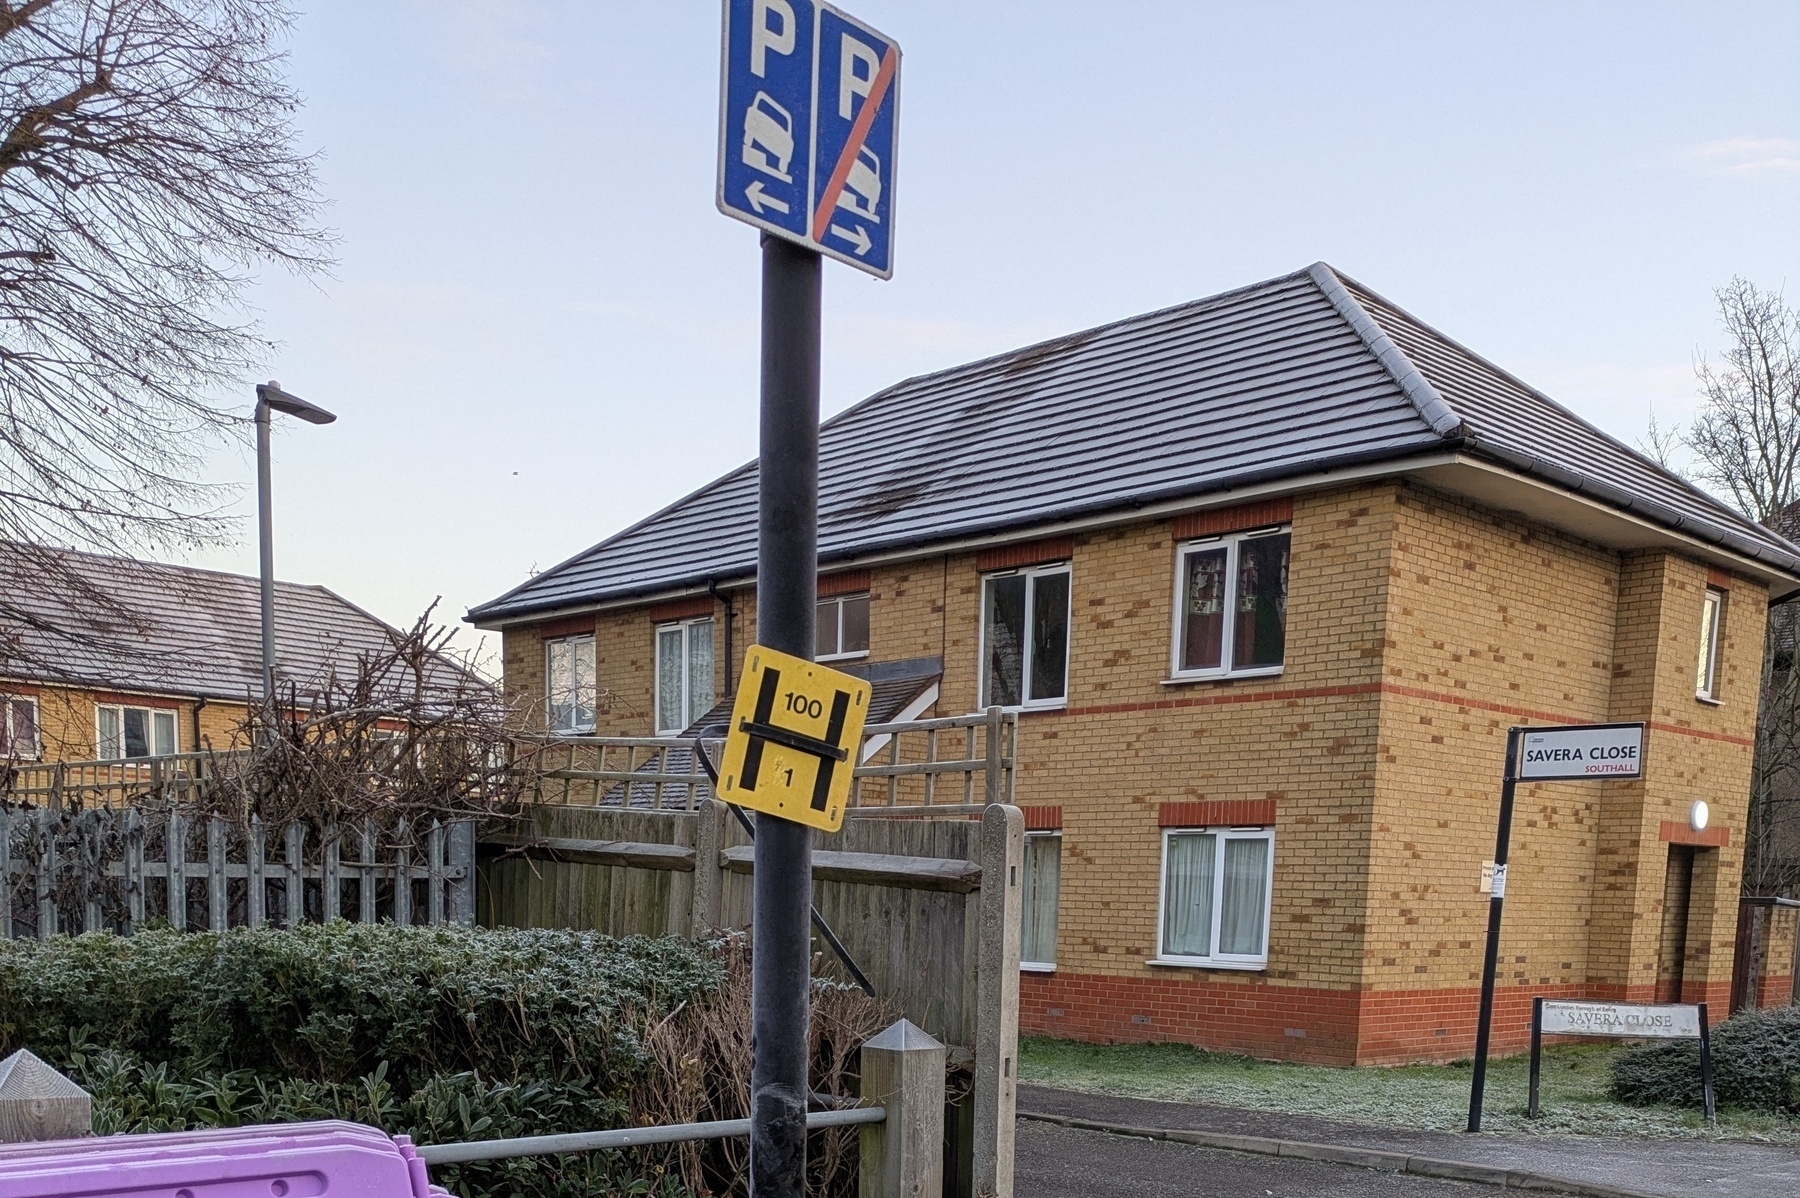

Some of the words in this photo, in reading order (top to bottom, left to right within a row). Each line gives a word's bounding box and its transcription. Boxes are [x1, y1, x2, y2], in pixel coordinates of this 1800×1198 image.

[751, 0, 796, 78] P
[839, 32, 881, 121] P
[785, 691, 823, 719] 100
[1526, 748, 1583, 762] SAVERA
[1589, 746, 1637, 760] CLOSE
[784, 768, 794, 787] 1
[1585, 764, 1635, 773] SOUTHALL
[1568, 1012, 1623, 1026] SAVERA
[1625, 1014, 1672, 1028] CLOSE
